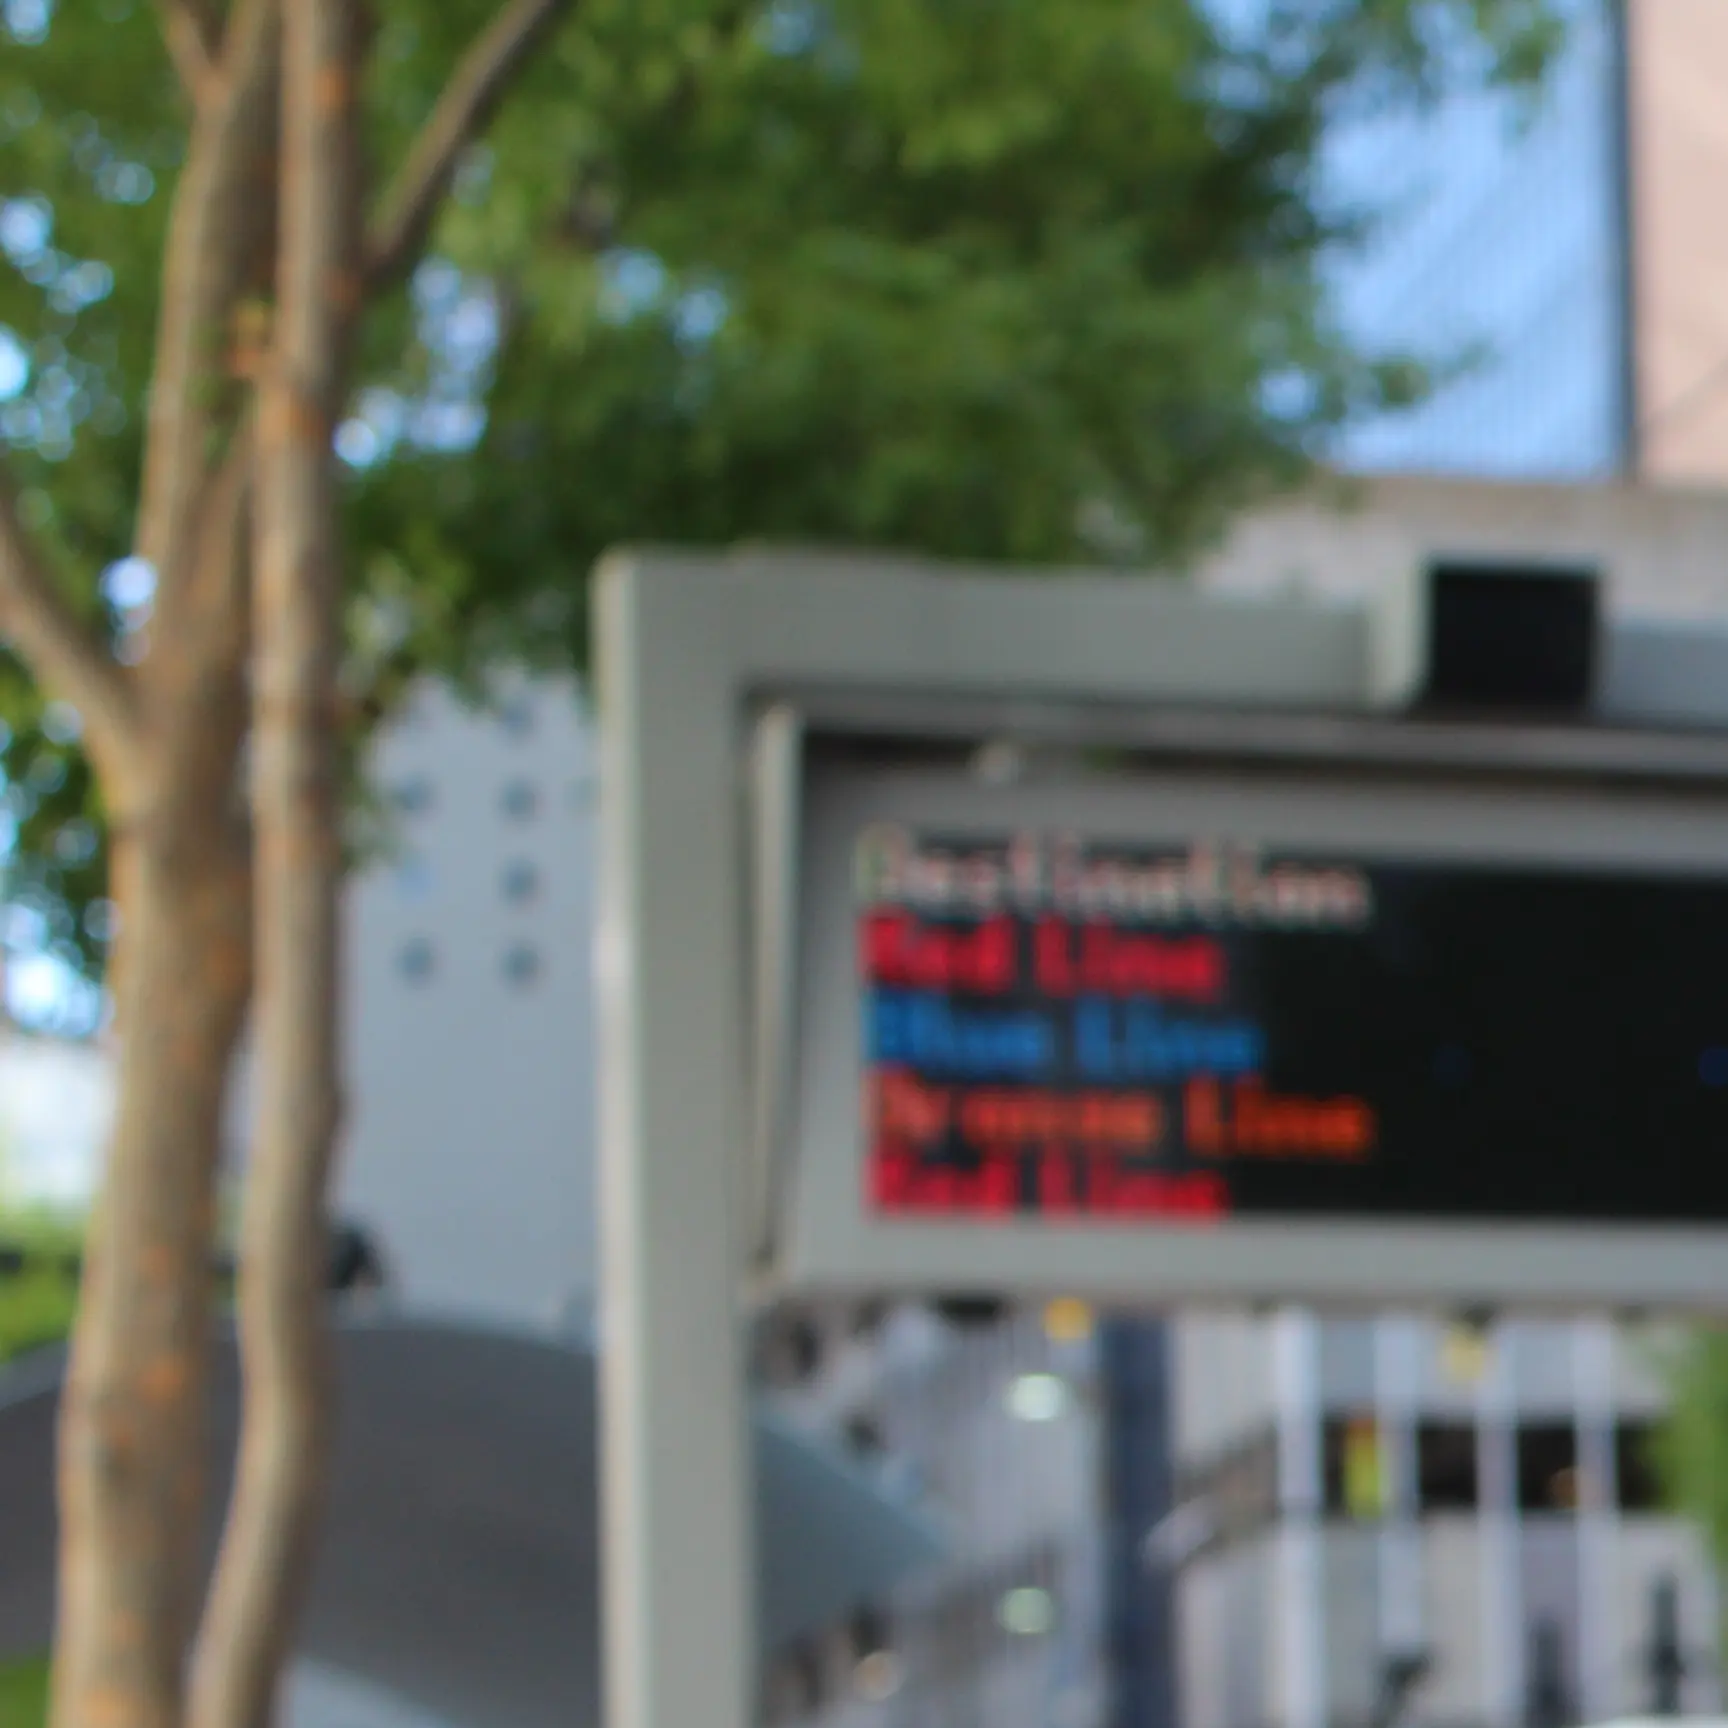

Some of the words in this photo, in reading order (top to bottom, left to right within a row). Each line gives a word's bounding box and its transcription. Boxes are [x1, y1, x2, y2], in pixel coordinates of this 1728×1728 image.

[856, 826, 1372, 930] Destination
[860, 905, 1016, 992] Red
[1032, 914, 1224, 1000] Line
[866, 986, 1053, 1080] Blue
[1074, 992, 1266, 1083] Line
[1185, 1072, 1374, 1160] Line
[868, 1135, 1020, 1222] Red
[1036, 1142, 1230, 1228] Line
